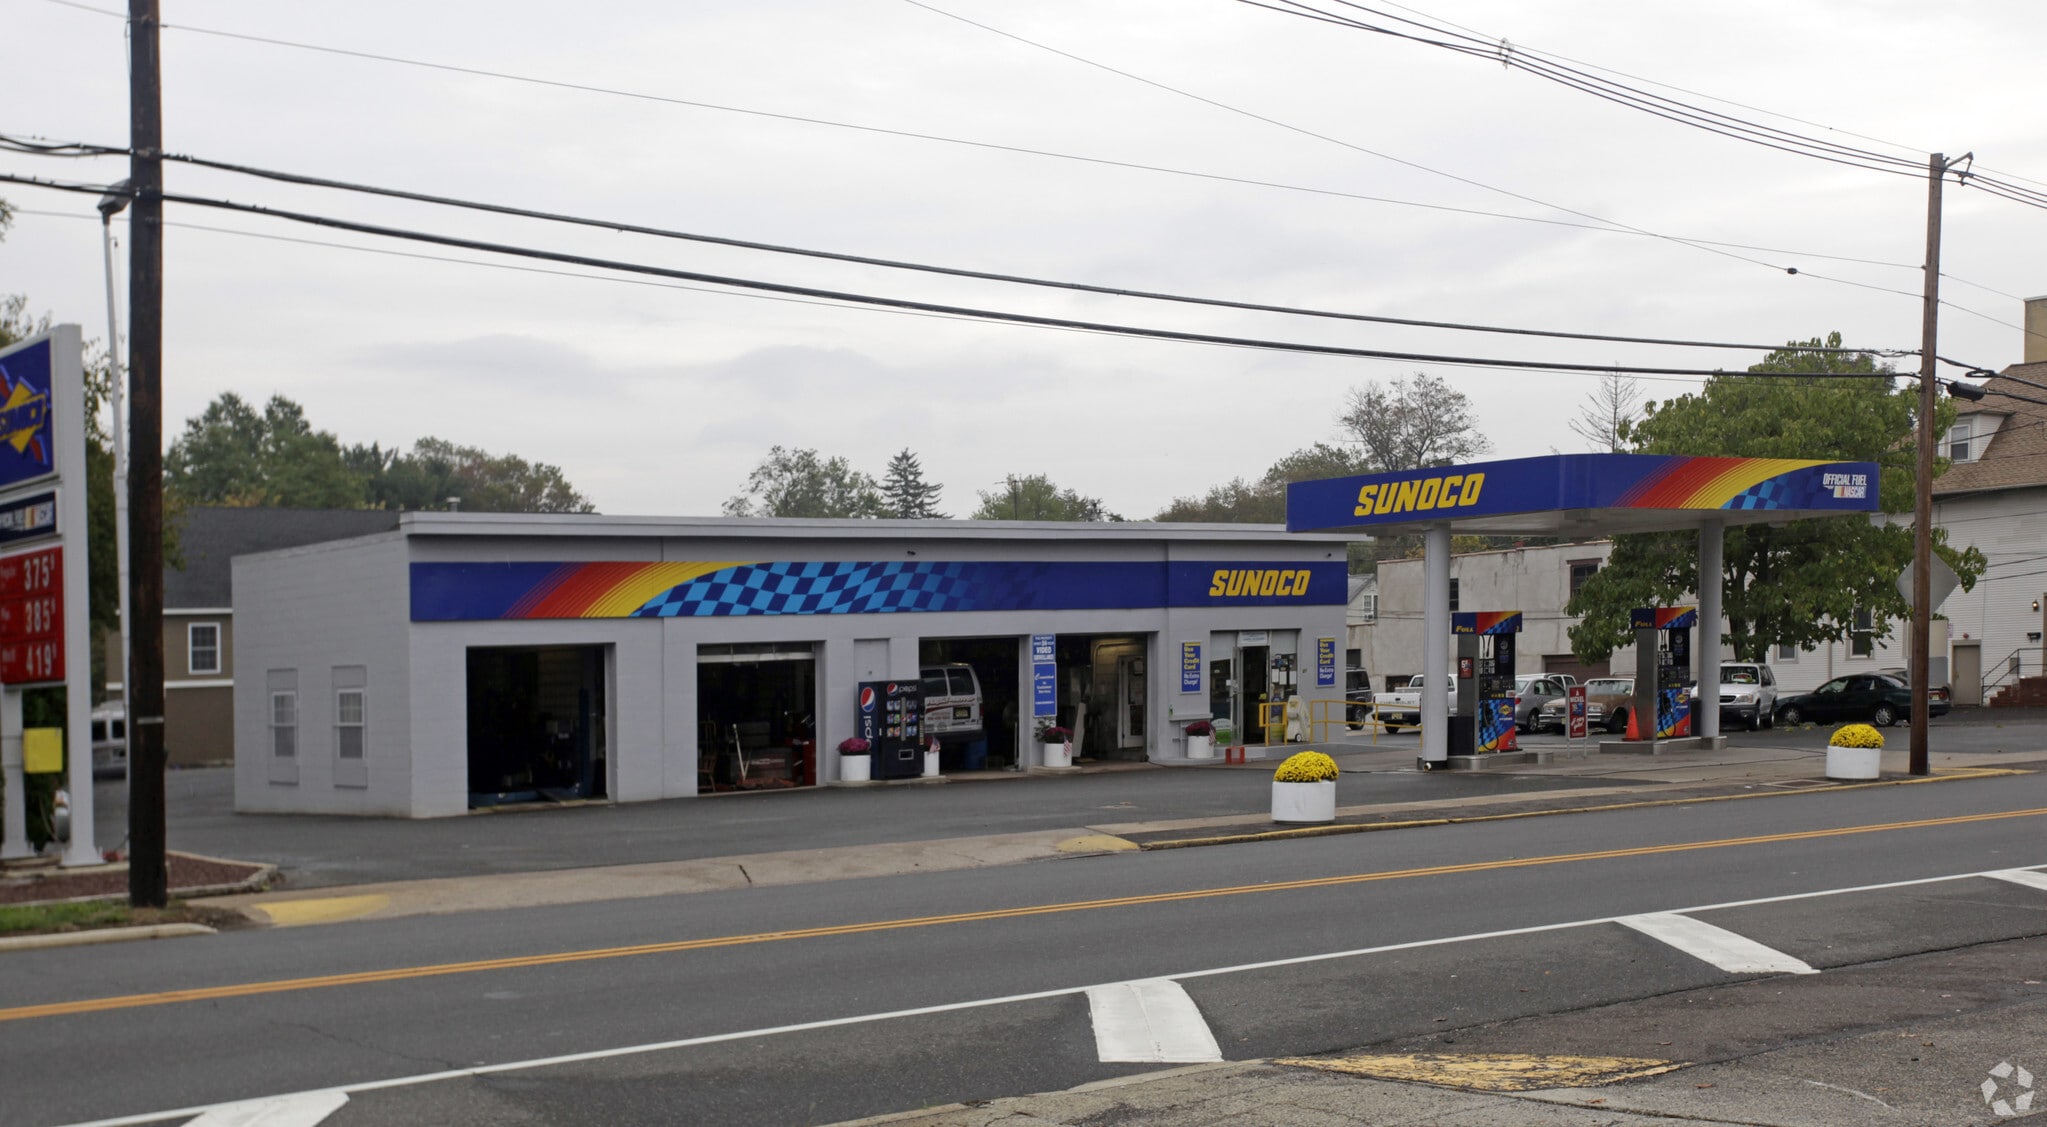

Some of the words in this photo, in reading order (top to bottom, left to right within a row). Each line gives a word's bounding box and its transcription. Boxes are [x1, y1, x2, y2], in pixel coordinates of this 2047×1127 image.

[1823, 473, 1850, 486] OFFICIAL
[1852, 474, 1867, 486] FUEL
[1353, 472, 1485, 517] SUNOCO
[1844, 486, 1866, 498] NASCAR
[1208, 569, 1312, 597] SUNOCO
